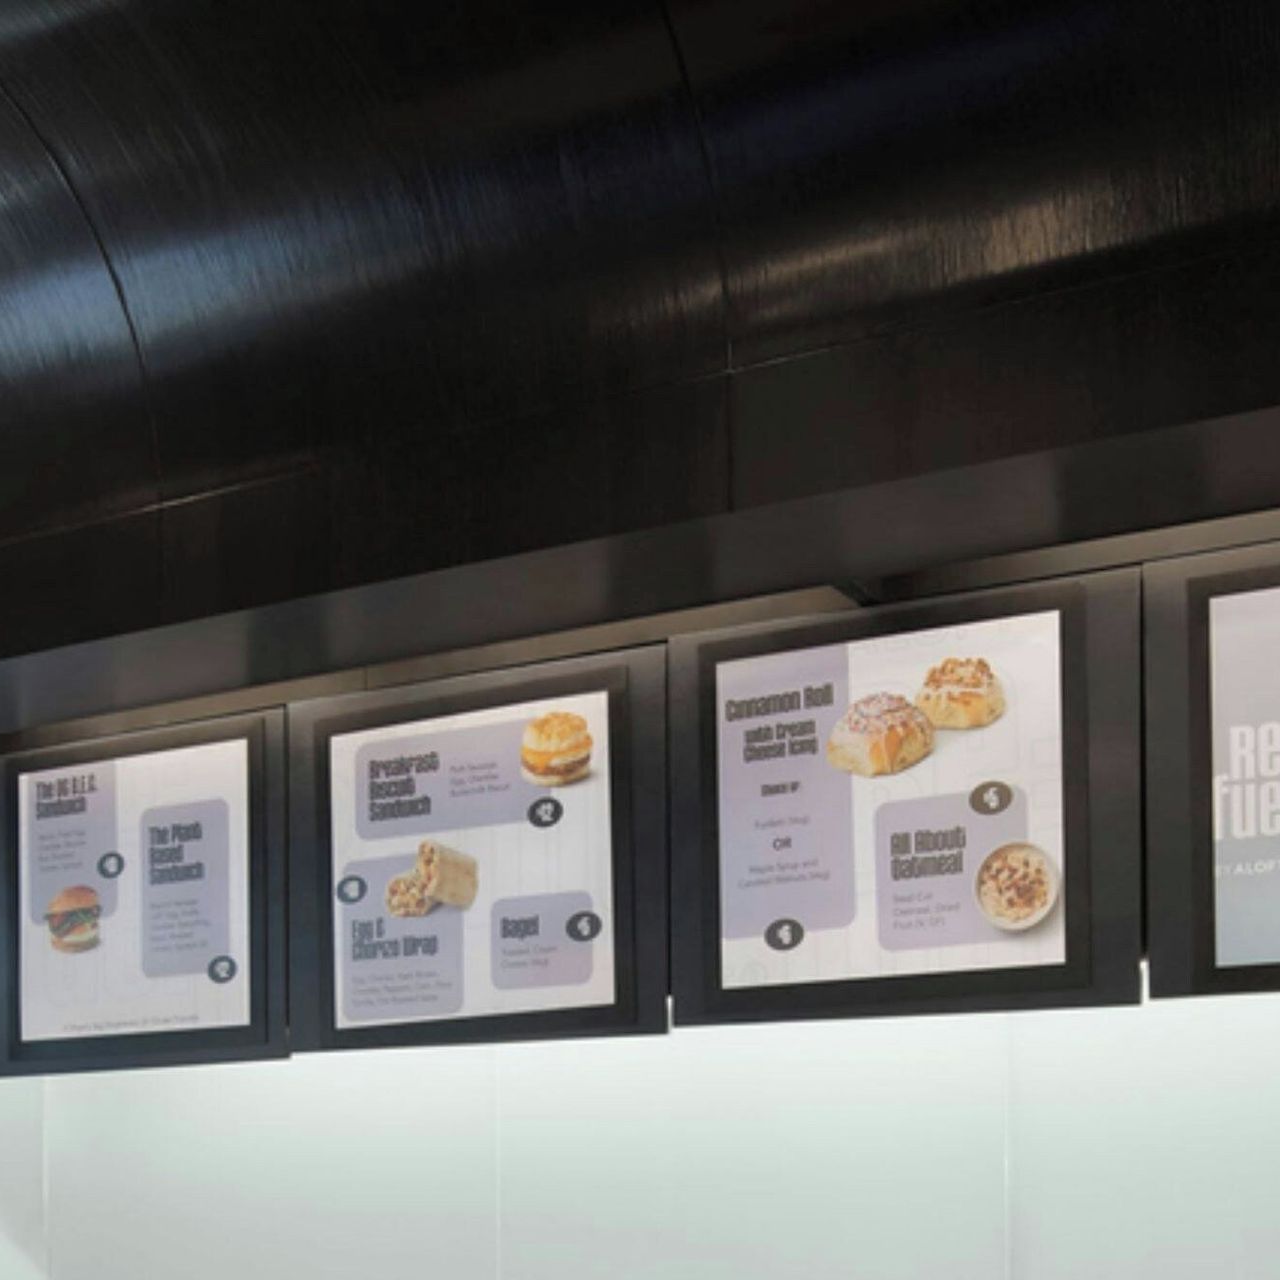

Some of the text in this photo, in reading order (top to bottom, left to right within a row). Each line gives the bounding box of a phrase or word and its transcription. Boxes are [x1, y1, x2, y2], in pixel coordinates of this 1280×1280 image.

[724, 682, 834, 722] Cinnamon Roll
[369, 751, 440, 780] Breakfast
[148, 827, 169, 845] The
[914, 825, 966, 852] About
[890, 852, 963, 881] Oatmeal
[501, 914, 539, 941] Bagel
